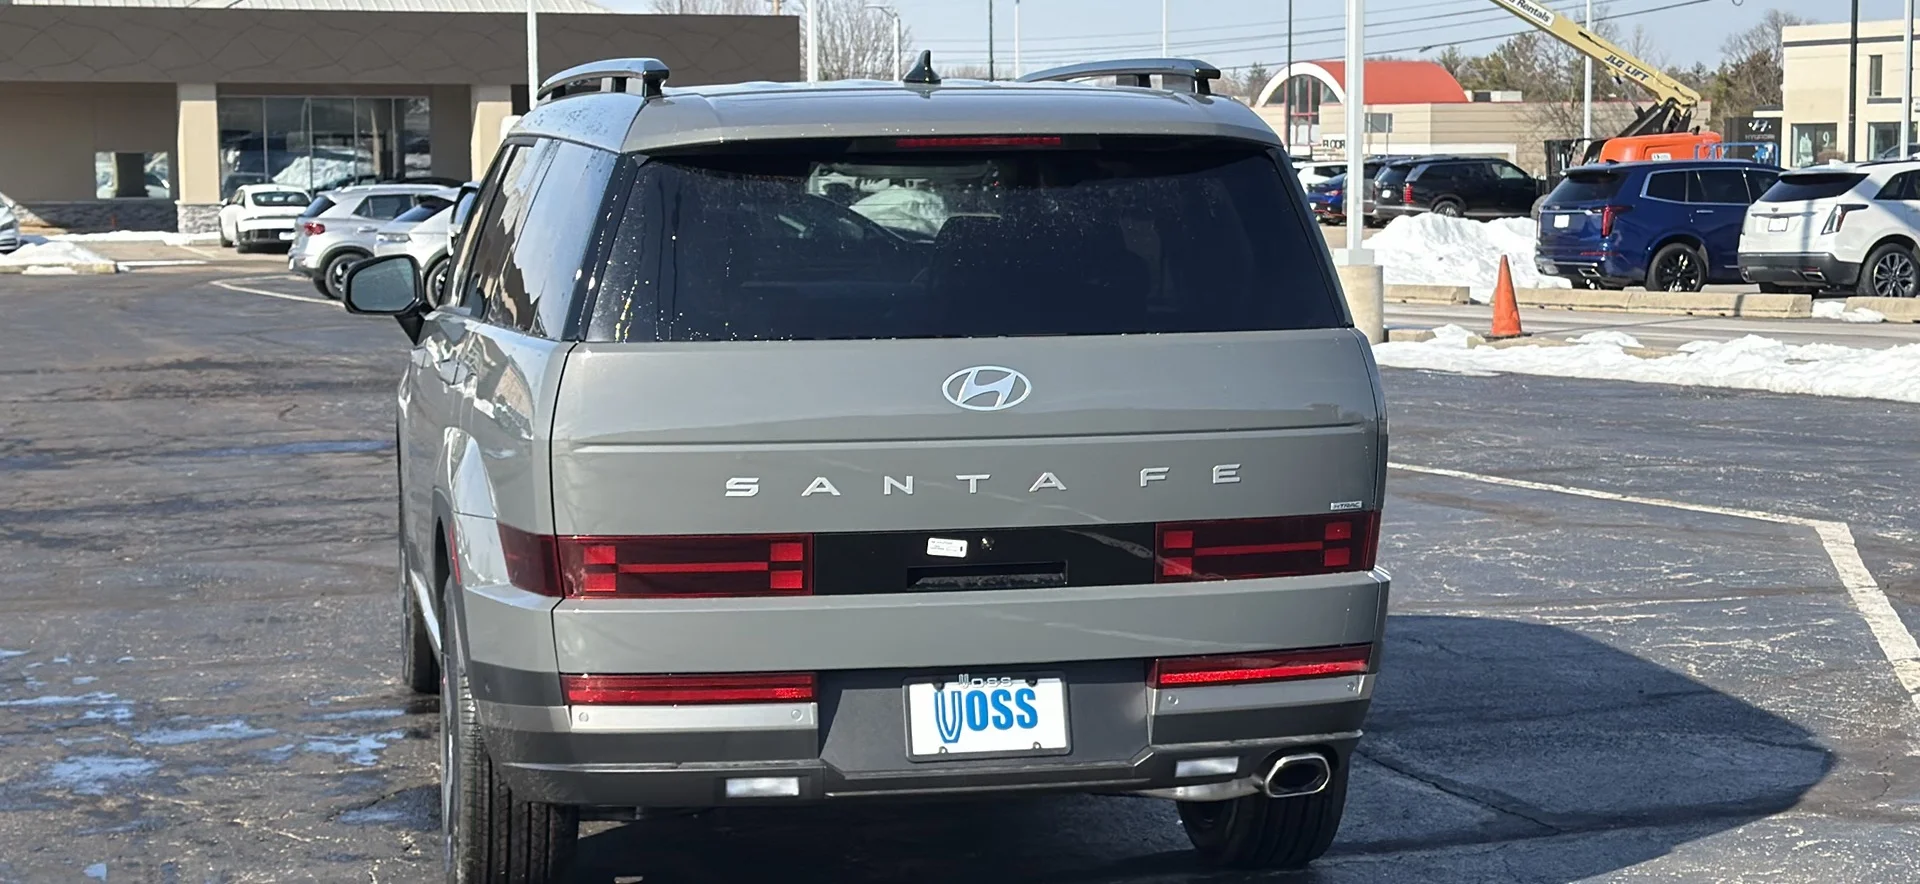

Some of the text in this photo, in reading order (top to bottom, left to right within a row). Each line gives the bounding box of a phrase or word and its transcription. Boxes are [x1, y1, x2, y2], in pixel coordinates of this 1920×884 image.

[1516, 0, 1550, 22] Rentals
[1604, 54, 1649, 81] JLG LIFT
[725, 463, 1242, 497] SANTA FE
[934, 687, 1038, 744] VOSS
